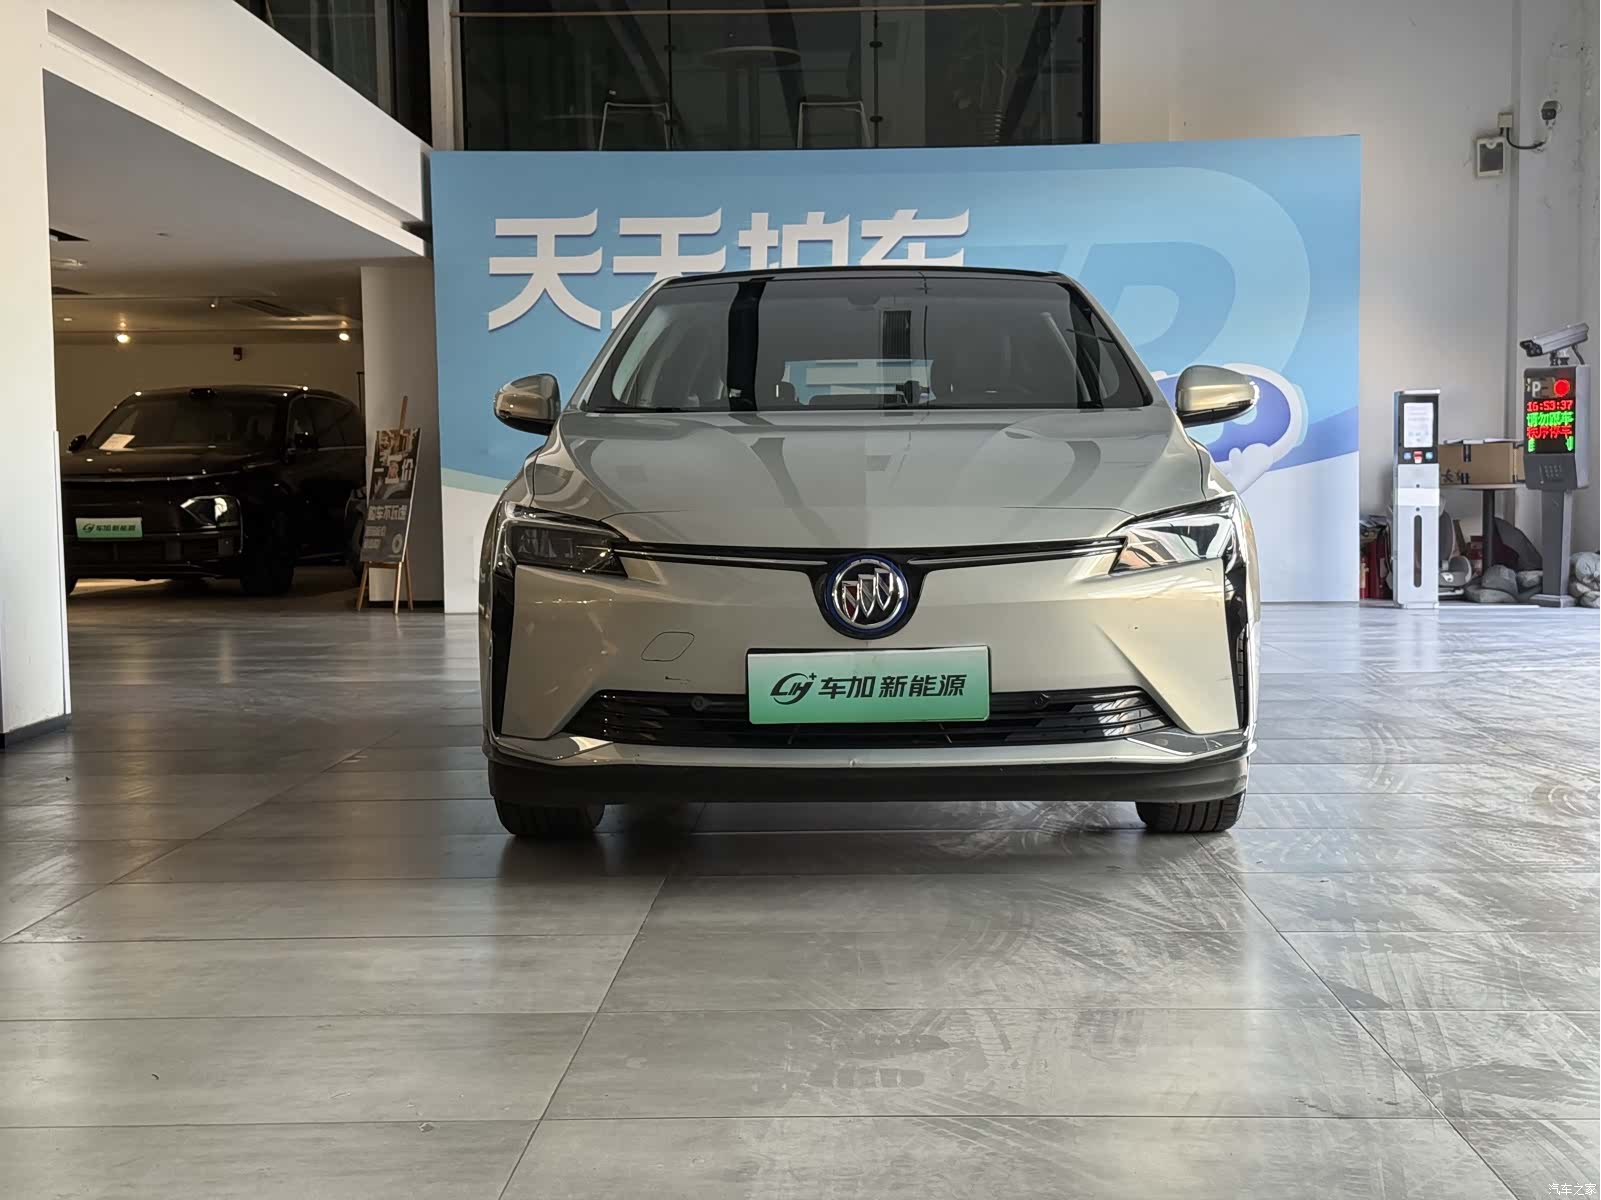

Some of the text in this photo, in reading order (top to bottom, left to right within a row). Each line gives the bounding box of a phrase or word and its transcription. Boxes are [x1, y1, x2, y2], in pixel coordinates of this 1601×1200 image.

[1526, 400, 1573, 411] 16:53:37
[818, 674, 967, 699] 车加新能源
